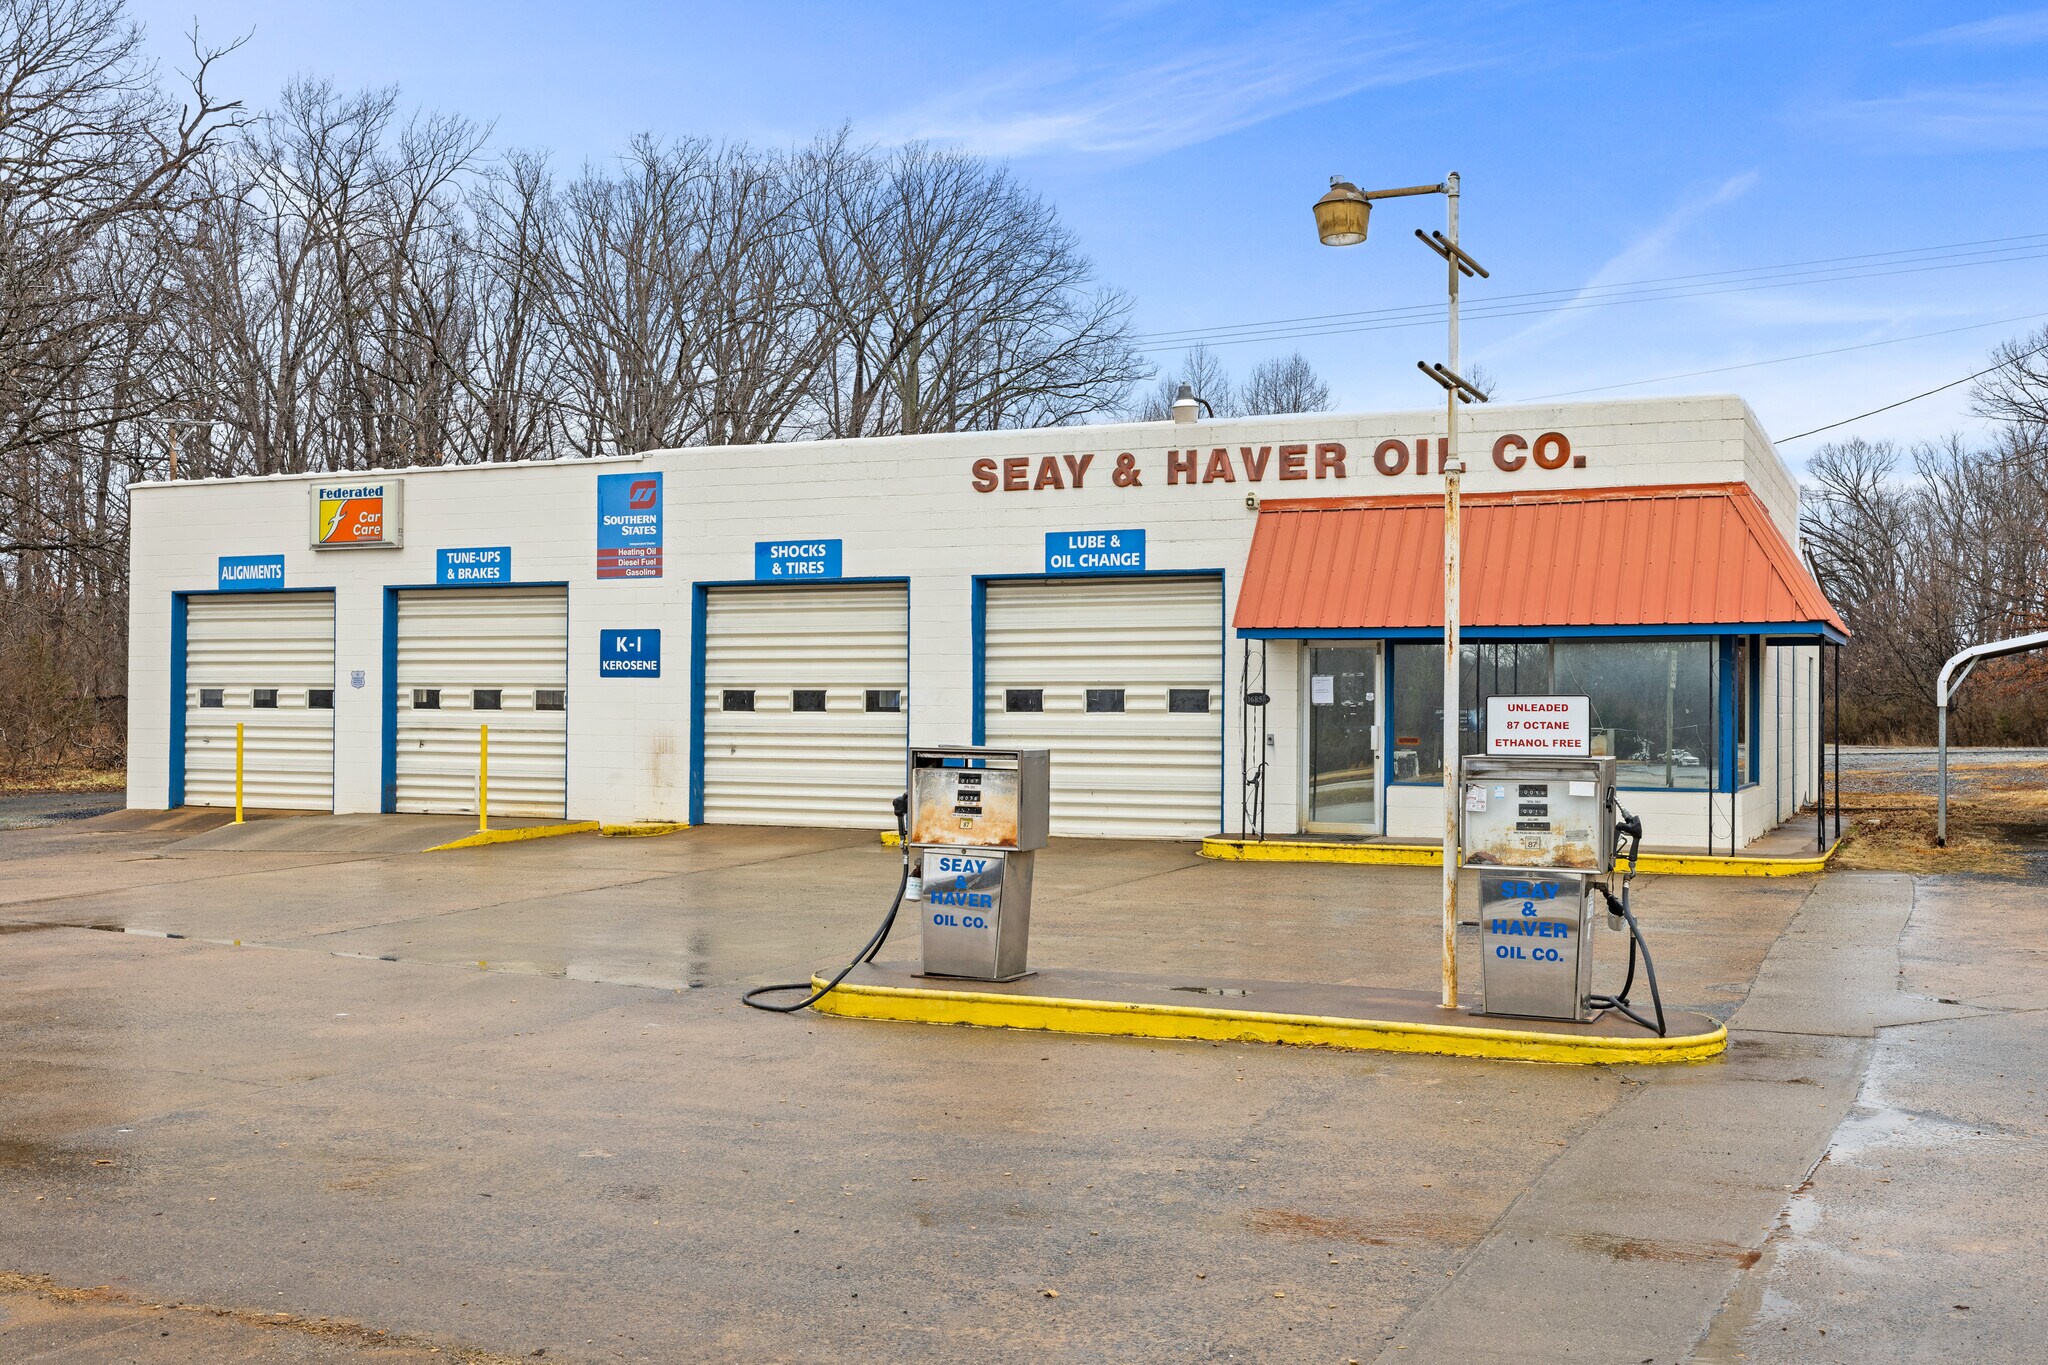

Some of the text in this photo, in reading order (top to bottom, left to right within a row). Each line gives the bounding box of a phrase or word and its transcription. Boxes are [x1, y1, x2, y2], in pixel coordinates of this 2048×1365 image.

[972, 431, 1587, 493] SEAY & HAVER OIL CO.
[319, 486, 383, 499] Federated
[359, 511, 381, 523] Car
[603, 515, 657, 525] SOUTHERN
[353, 524, 381, 535] Care
[621, 525, 657, 535] STATES
[1068, 534, 1121, 549] LUBE &
[446, 551, 501, 564] TUNE-UPS
[618, 547, 656, 556] Heating Oil
[770, 544, 826, 558] SHOCKS
[618, 558, 656, 567] Diesel Fuel
[1050, 552, 1140, 568] OIL CHANGE
[221, 564, 282, 580] ALIGNMENTS
[447, 567, 500, 580] & BRAKES
[625, 568, 656, 576] Gasoline
[771, 561, 825, 575] & TIRES
[602, 660, 658, 670] KEROSENE
[1507, 703, 1569, 712] UNLEADED
[1506, 721, 1570, 730] 87 OCTANE
[1495, 738, 1582, 748] ETHANOL FREE
[939, 857, 987, 874] SEAY
[955, 875, 968, 889] &
[1501, 881, 1560, 899] SEAY
[930, 890, 992, 908] HAVER
[1521, 901, 1538, 917] &
[933, 914, 988, 929] OIL CO.
[1491, 919, 1568, 938] HAVER
[1496, 945, 1564, 963] OIL CO.
